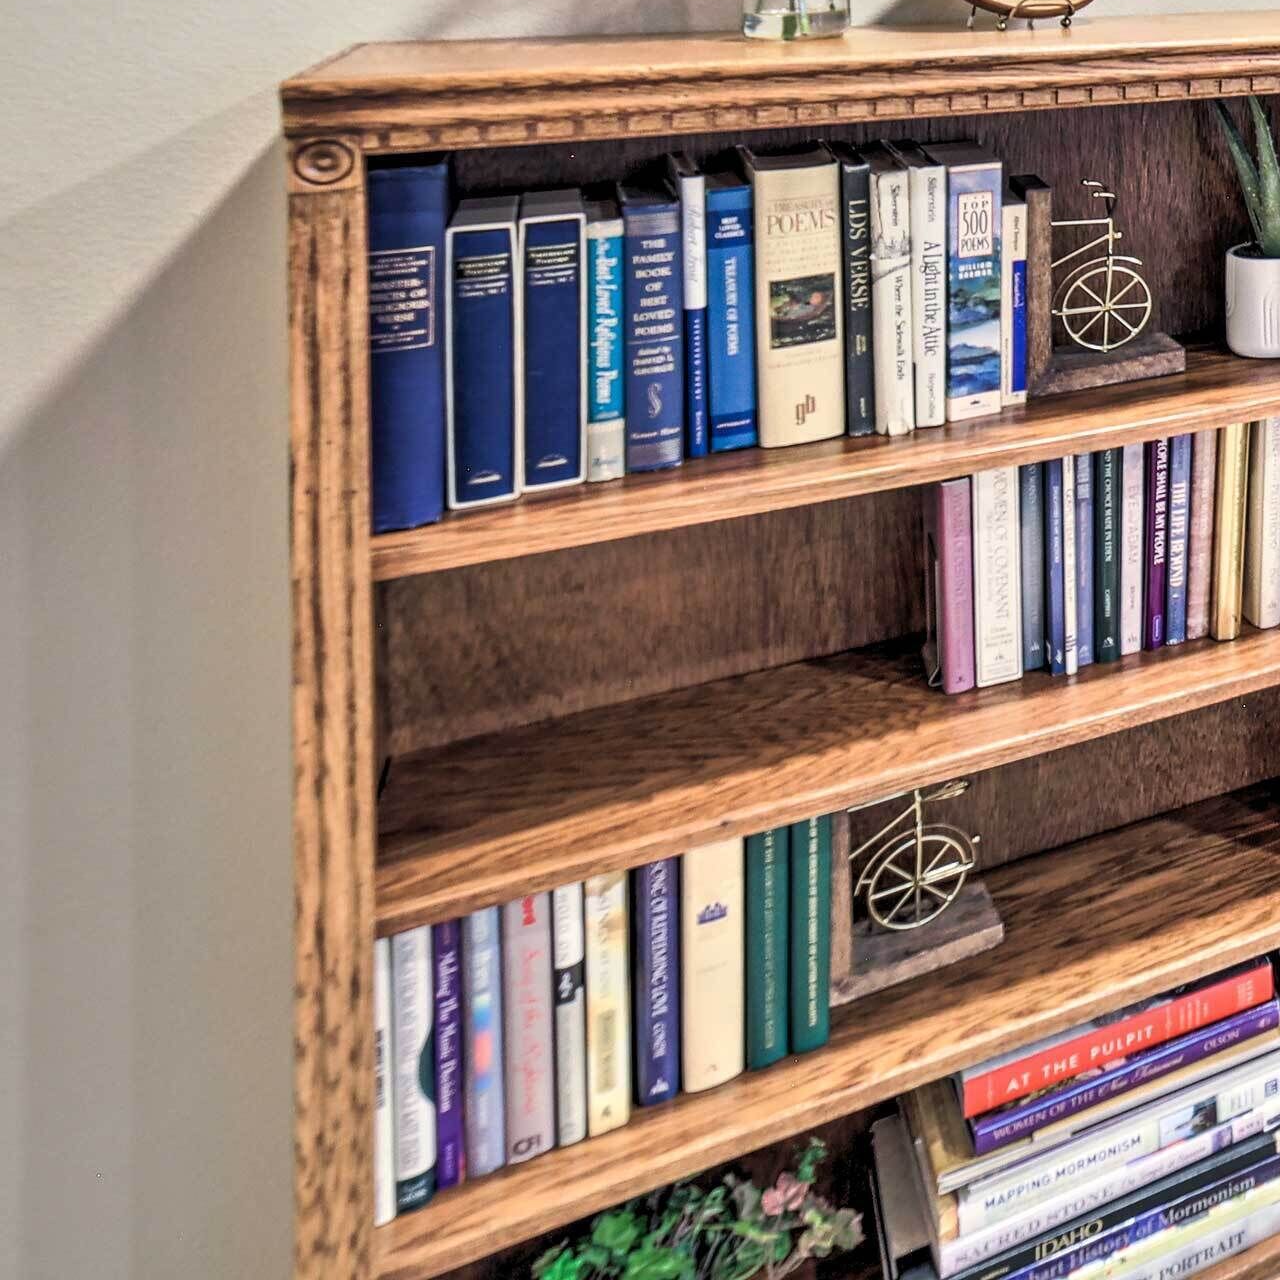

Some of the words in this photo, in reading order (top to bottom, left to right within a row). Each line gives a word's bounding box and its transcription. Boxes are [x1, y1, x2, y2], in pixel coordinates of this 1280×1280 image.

[926, 176, 937, 223] Silverstein
[963, 200, 988, 210] TOP
[766, 209, 836, 236] POEMS
[963, 210, 988, 236] 500
[632, 250, 674, 265] FAMILY
[640, 239, 666, 249] THE
[923, 240, 941, 252] A
[961, 237, 989, 253] POEMS
[635, 266, 672, 279] BOOK
[724, 256, 738, 306] TREASURY
[850, 246, 870, 312] VERSE
[919, 253, 942, 287] Light
[645, 281, 663, 292] OF
[894, 275, 904, 302] Where
[923, 288, 940, 301] in
[640, 296, 669, 307] BEST
[727, 308, 738, 322] OF
[895, 303, 904, 318] the
[923, 302, 941, 324] the
[633, 309, 675, 322] LOVED
[590, 318, 619, 369] Religious
[634, 324, 675, 337] POEMS
[726, 324, 740, 356] POEMS
[894, 320, 906, 356] Sidewalk
[922, 325, 943, 357] Attic
[896, 359, 906, 381] Ends
[595, 371, 619, 405] Poems
[1128, 485, 1138, 509] EVE
[1155, 471, 1167, 500] SHALL
[1171, 481, 1186, 506] THE
[1155, 501, 1167, 513] BE
[995, 524, 1008, 541] OF
[1154, 514, 1166, 529] MY
[1170, 509, 1185, 536] LIFE
[1104, 541, 1113, 562] EDEN
[1127, 526, 1138, 565] ADAM
[1153, 531, 1165, 565] PEOPLE
[1169, 538, 1185, 587] BEYOND
[994, 546, 1009, 619] COVENANT
[436, 950, 458, 998] Making
[438, 997, 459, 1021] The
[438, 1022, 458, 1058] Music
[1007, 1073, 1031, 1093] AT
[1041, 1053, 1079, 1079] THE
[1090, 1024, 1155, 1059] PULPIT
[439, 1060, 458, 1113] Decision
[994, 1108, 1047, 1140] WOMEN
[1050, 1098, 1067, 1115] OF
[1070, 1091, 1095, 1108] THE
[1130, 1055, 1184, 1083] Testament
[1203, 1028, 1241, 1051] OLSON
[984, 1173, 1051, 1210] MAPPING
[1054, 1135, 1142, 1179] MORMONISM
[955, 1217, 1042, 1265] SACRED
[1049, 1185, 1114, 1220] STONE
[1069, 1230, 1129, 1268] History
[1133, 1220, 1153, 1240] of
[1160, 1176, 1257, 1224] Mormonism
[1035, 1219, 1104, 1260] IDAHO
[1159, 1230, 1245, 1280] PORTRAIT
